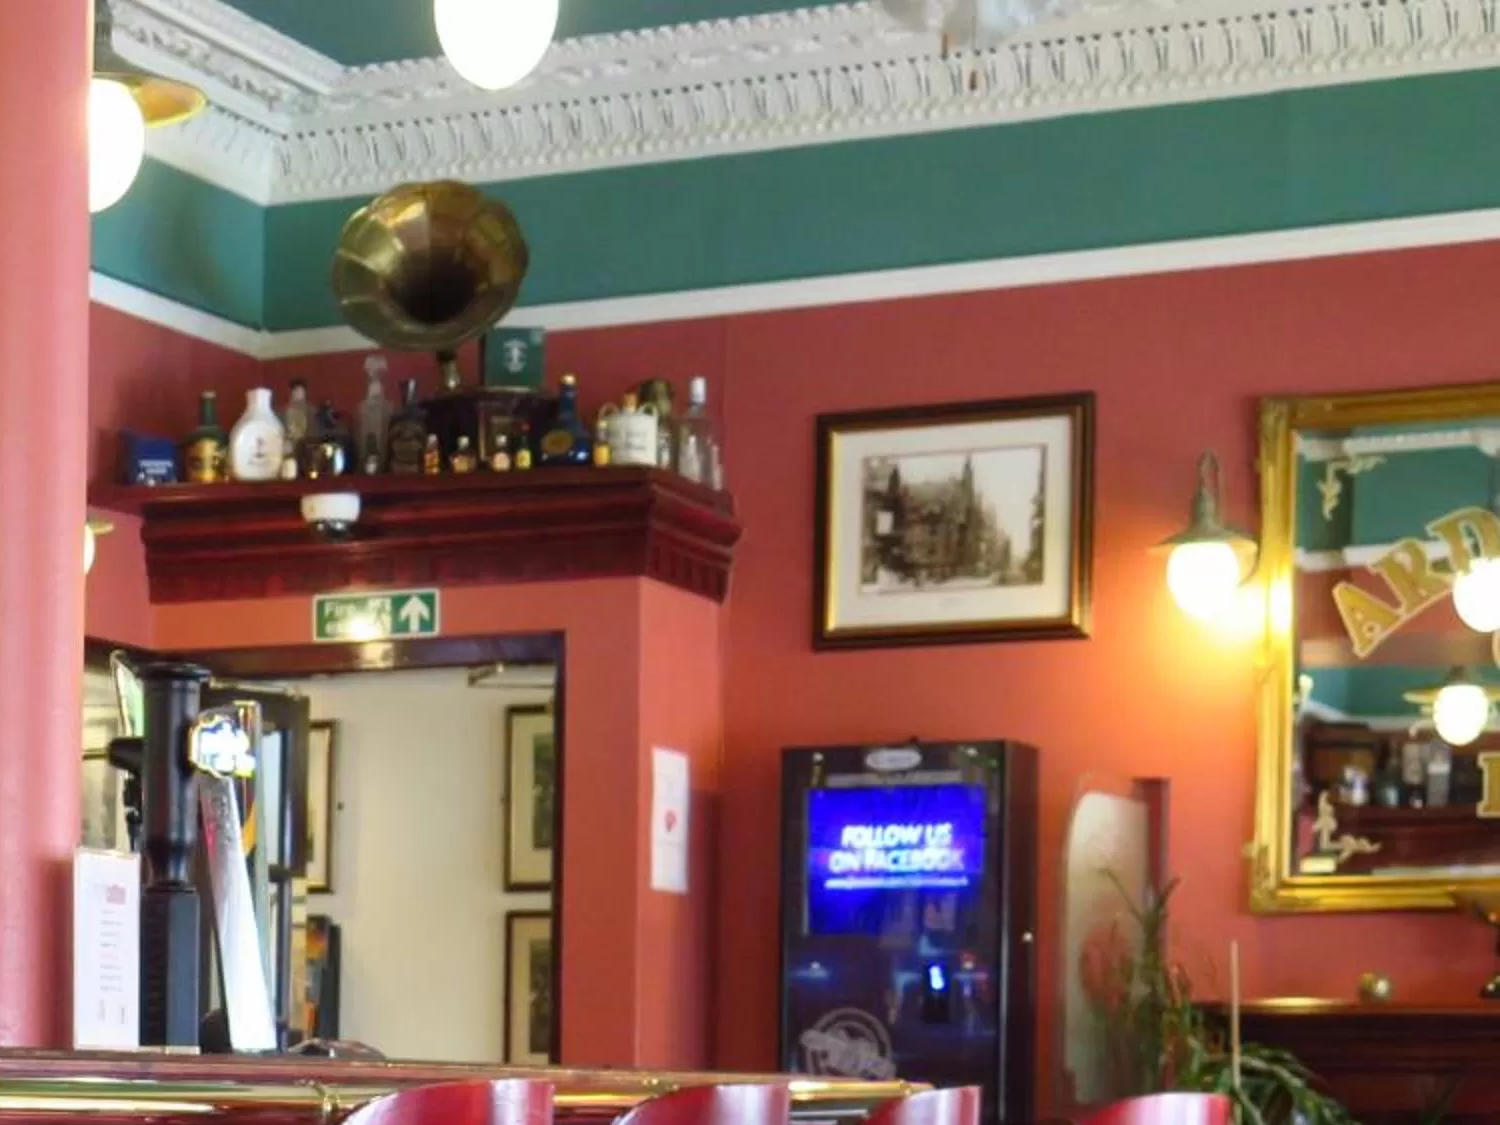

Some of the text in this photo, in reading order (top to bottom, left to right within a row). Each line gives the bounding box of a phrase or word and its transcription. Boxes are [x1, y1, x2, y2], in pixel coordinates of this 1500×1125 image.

[841, 821, 953, 849] FOLLOW US
[829, 849, 965, 873] ON FACEBOOK
